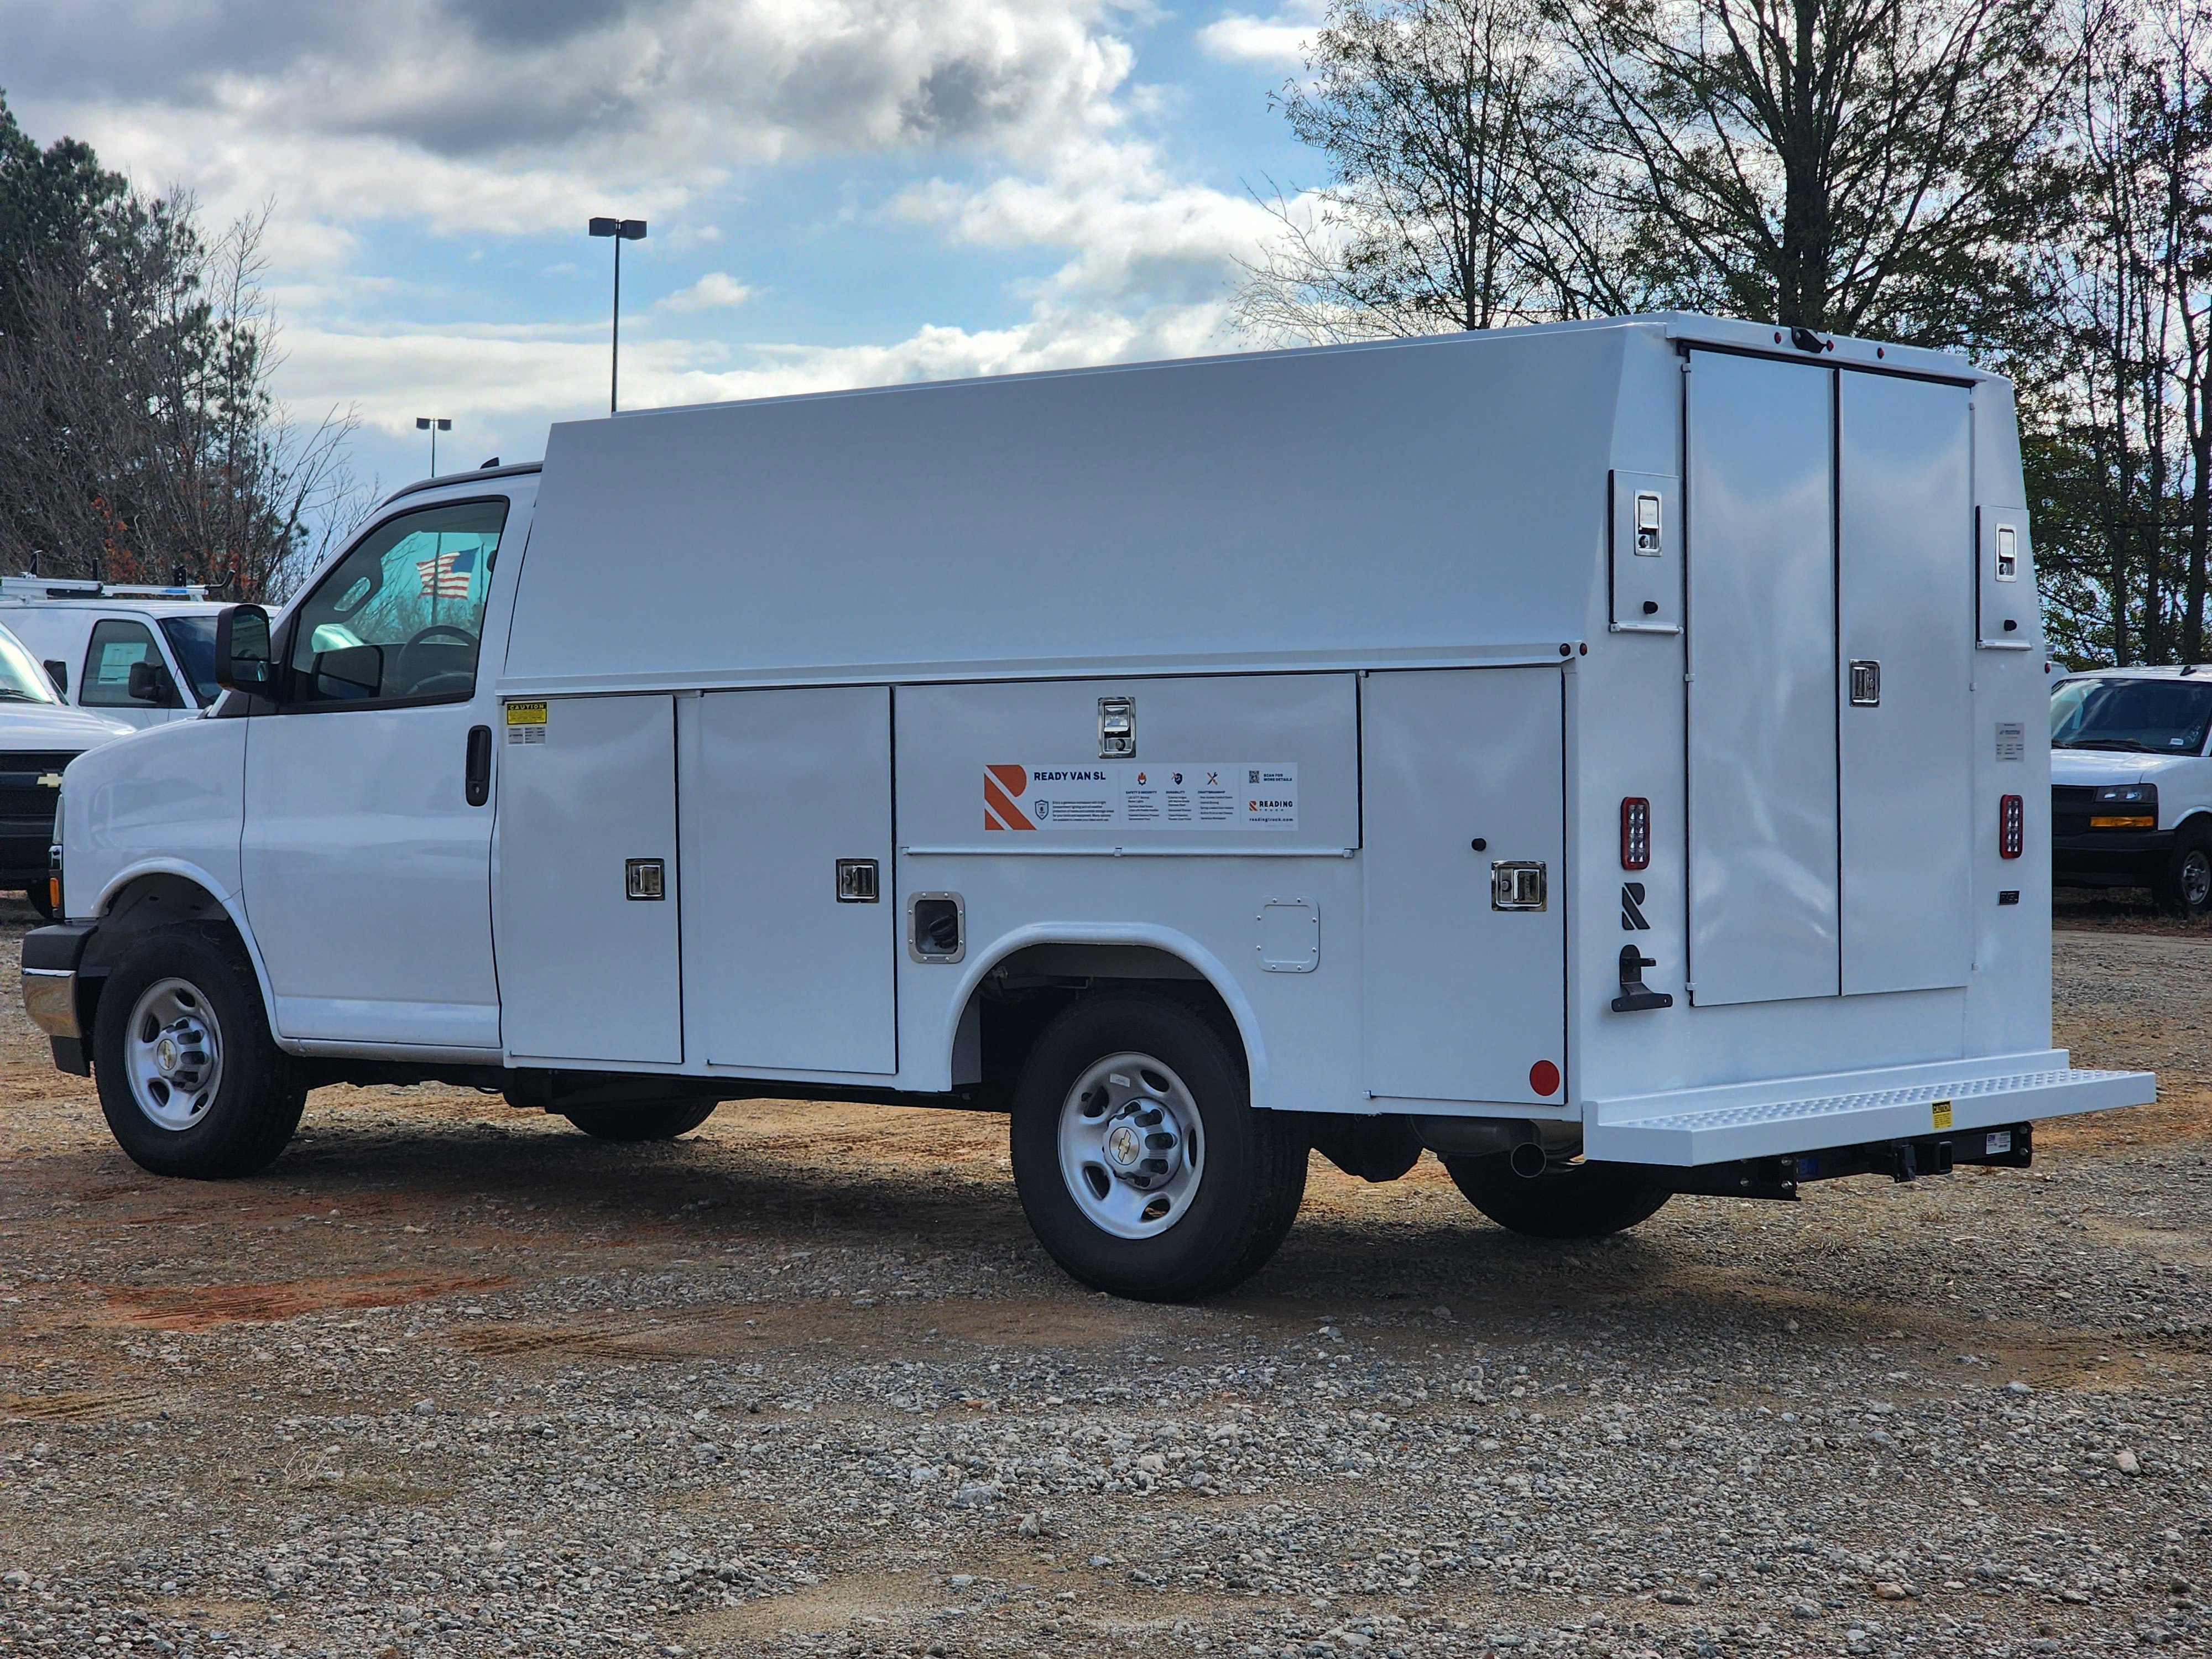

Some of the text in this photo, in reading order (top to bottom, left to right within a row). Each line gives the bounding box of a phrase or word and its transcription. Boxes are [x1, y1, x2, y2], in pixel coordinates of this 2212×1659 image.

[1034, 771, 1106, 781] READY VAN SL
